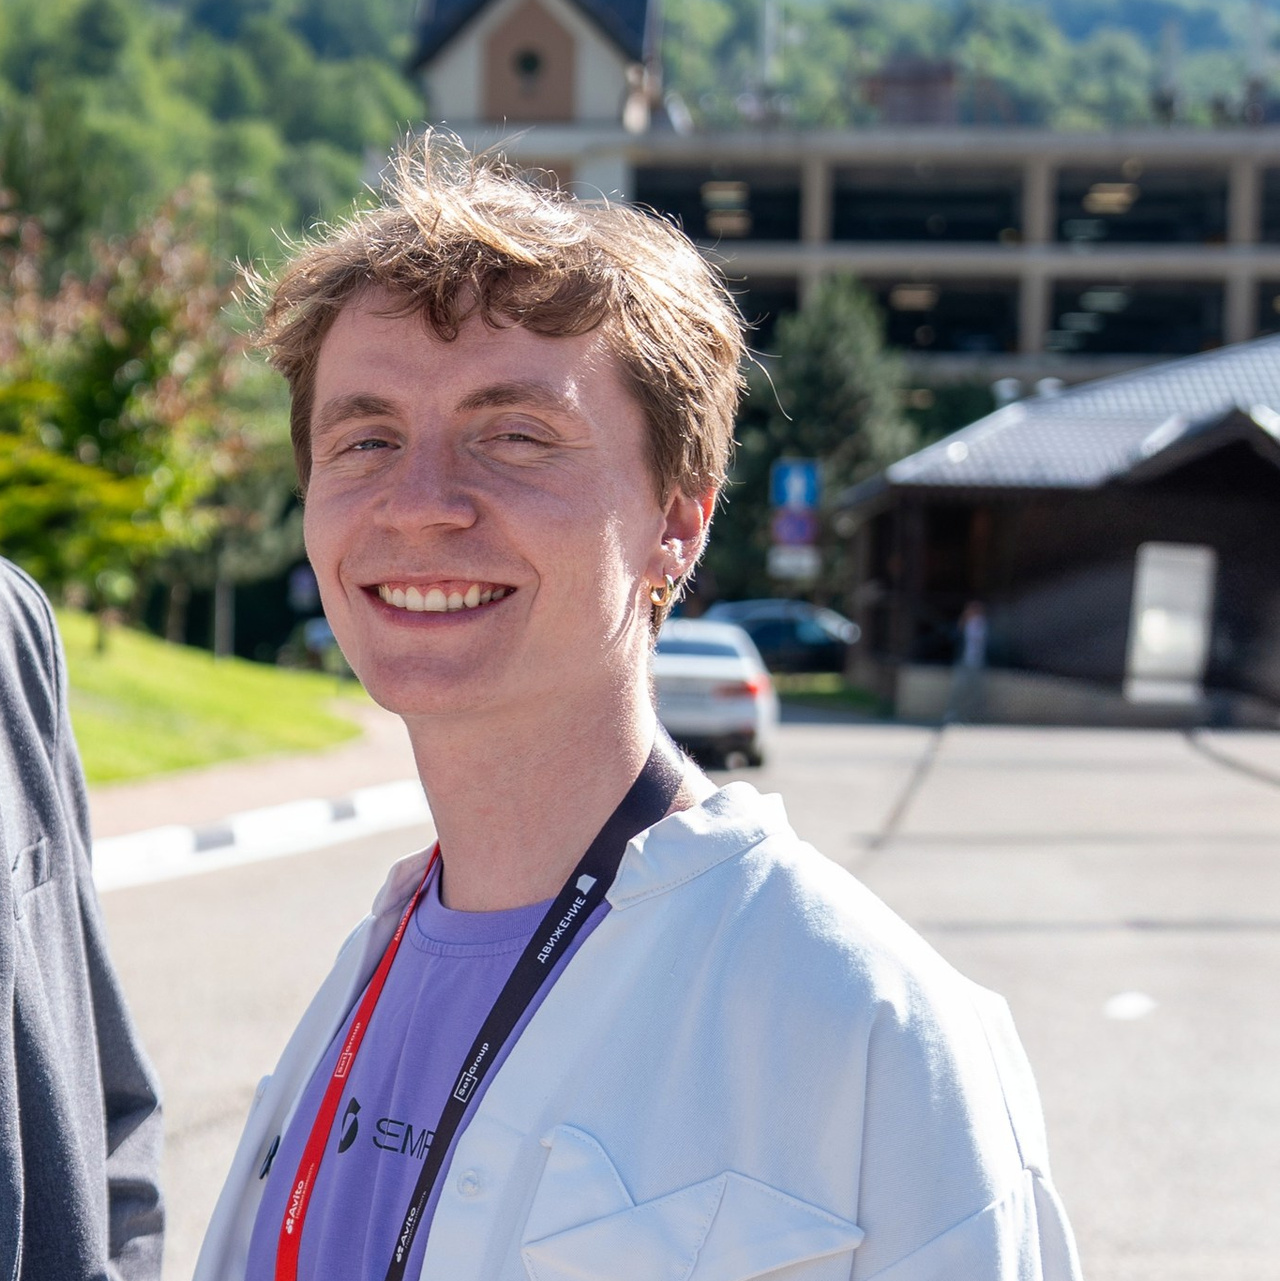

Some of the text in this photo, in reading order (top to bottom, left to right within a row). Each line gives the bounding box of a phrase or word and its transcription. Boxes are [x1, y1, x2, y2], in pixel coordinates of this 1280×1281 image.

[537, 896, 586, 964] ДВИЖЕНИЕ
[468, 1042, 489, 1075] Group
[289, 1180, 305, 1218] Avito
[401, 1207, 416, 1246] Avito
